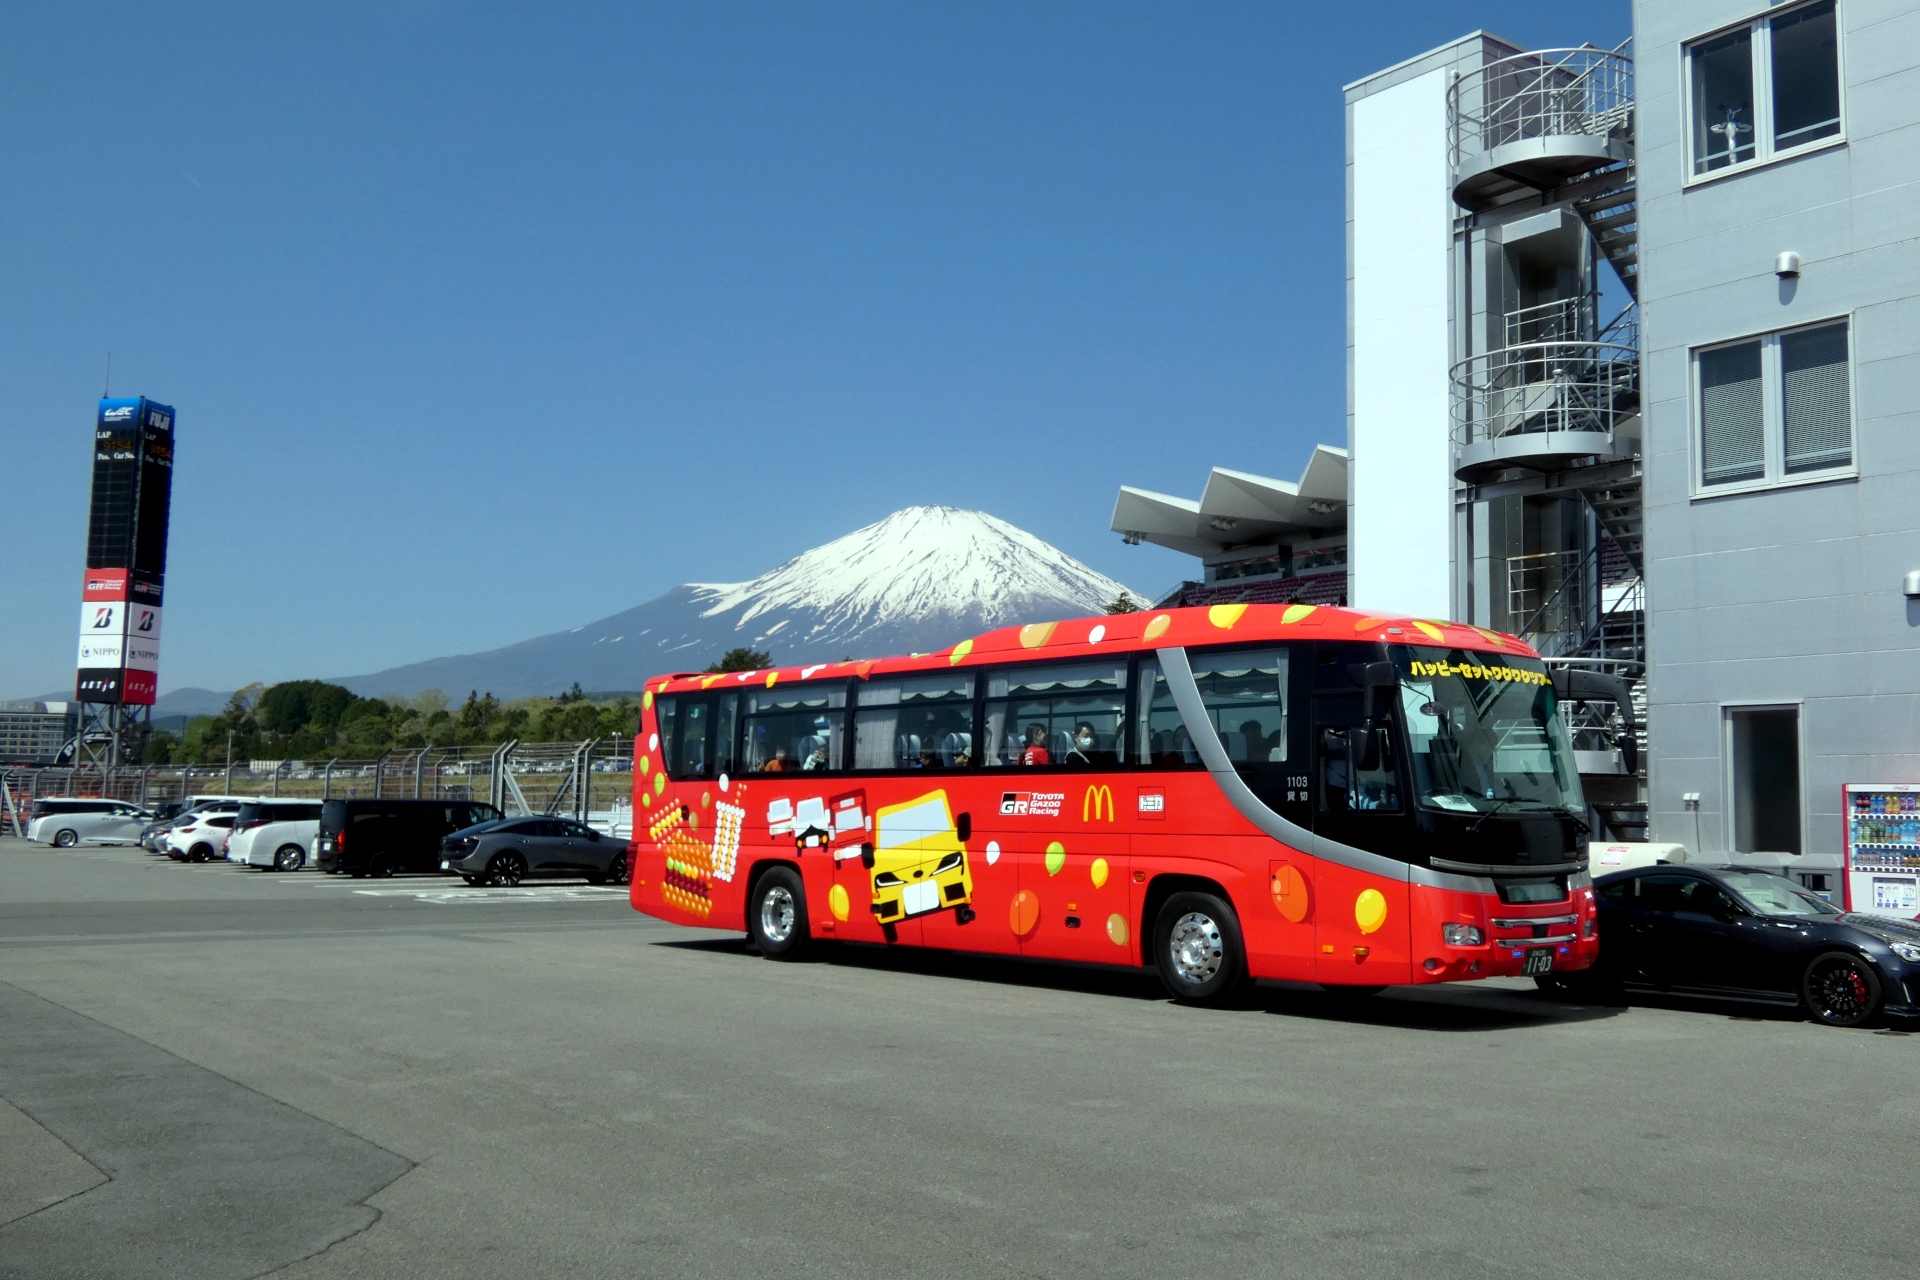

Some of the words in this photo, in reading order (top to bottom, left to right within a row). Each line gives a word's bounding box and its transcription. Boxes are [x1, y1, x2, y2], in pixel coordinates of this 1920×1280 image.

[105, 407, 134, 416] WEC
[149, 411, 171, 431] FUJI
[97, 431, 112, 439] LAP
[145, 432, 157, 441] LAP
[92, 647, 120, 656] NIPPO
[137, 650, 159, 660] NIPPO
[1286, 776, 1308, 788] 1103
[1031, 792, 1065, 800] TOYOTA
[1001, 800, 1028, 814] GR
[1138, 794, 1165, 812] トミカ
[1029, 807, 1060, 817] Racing
